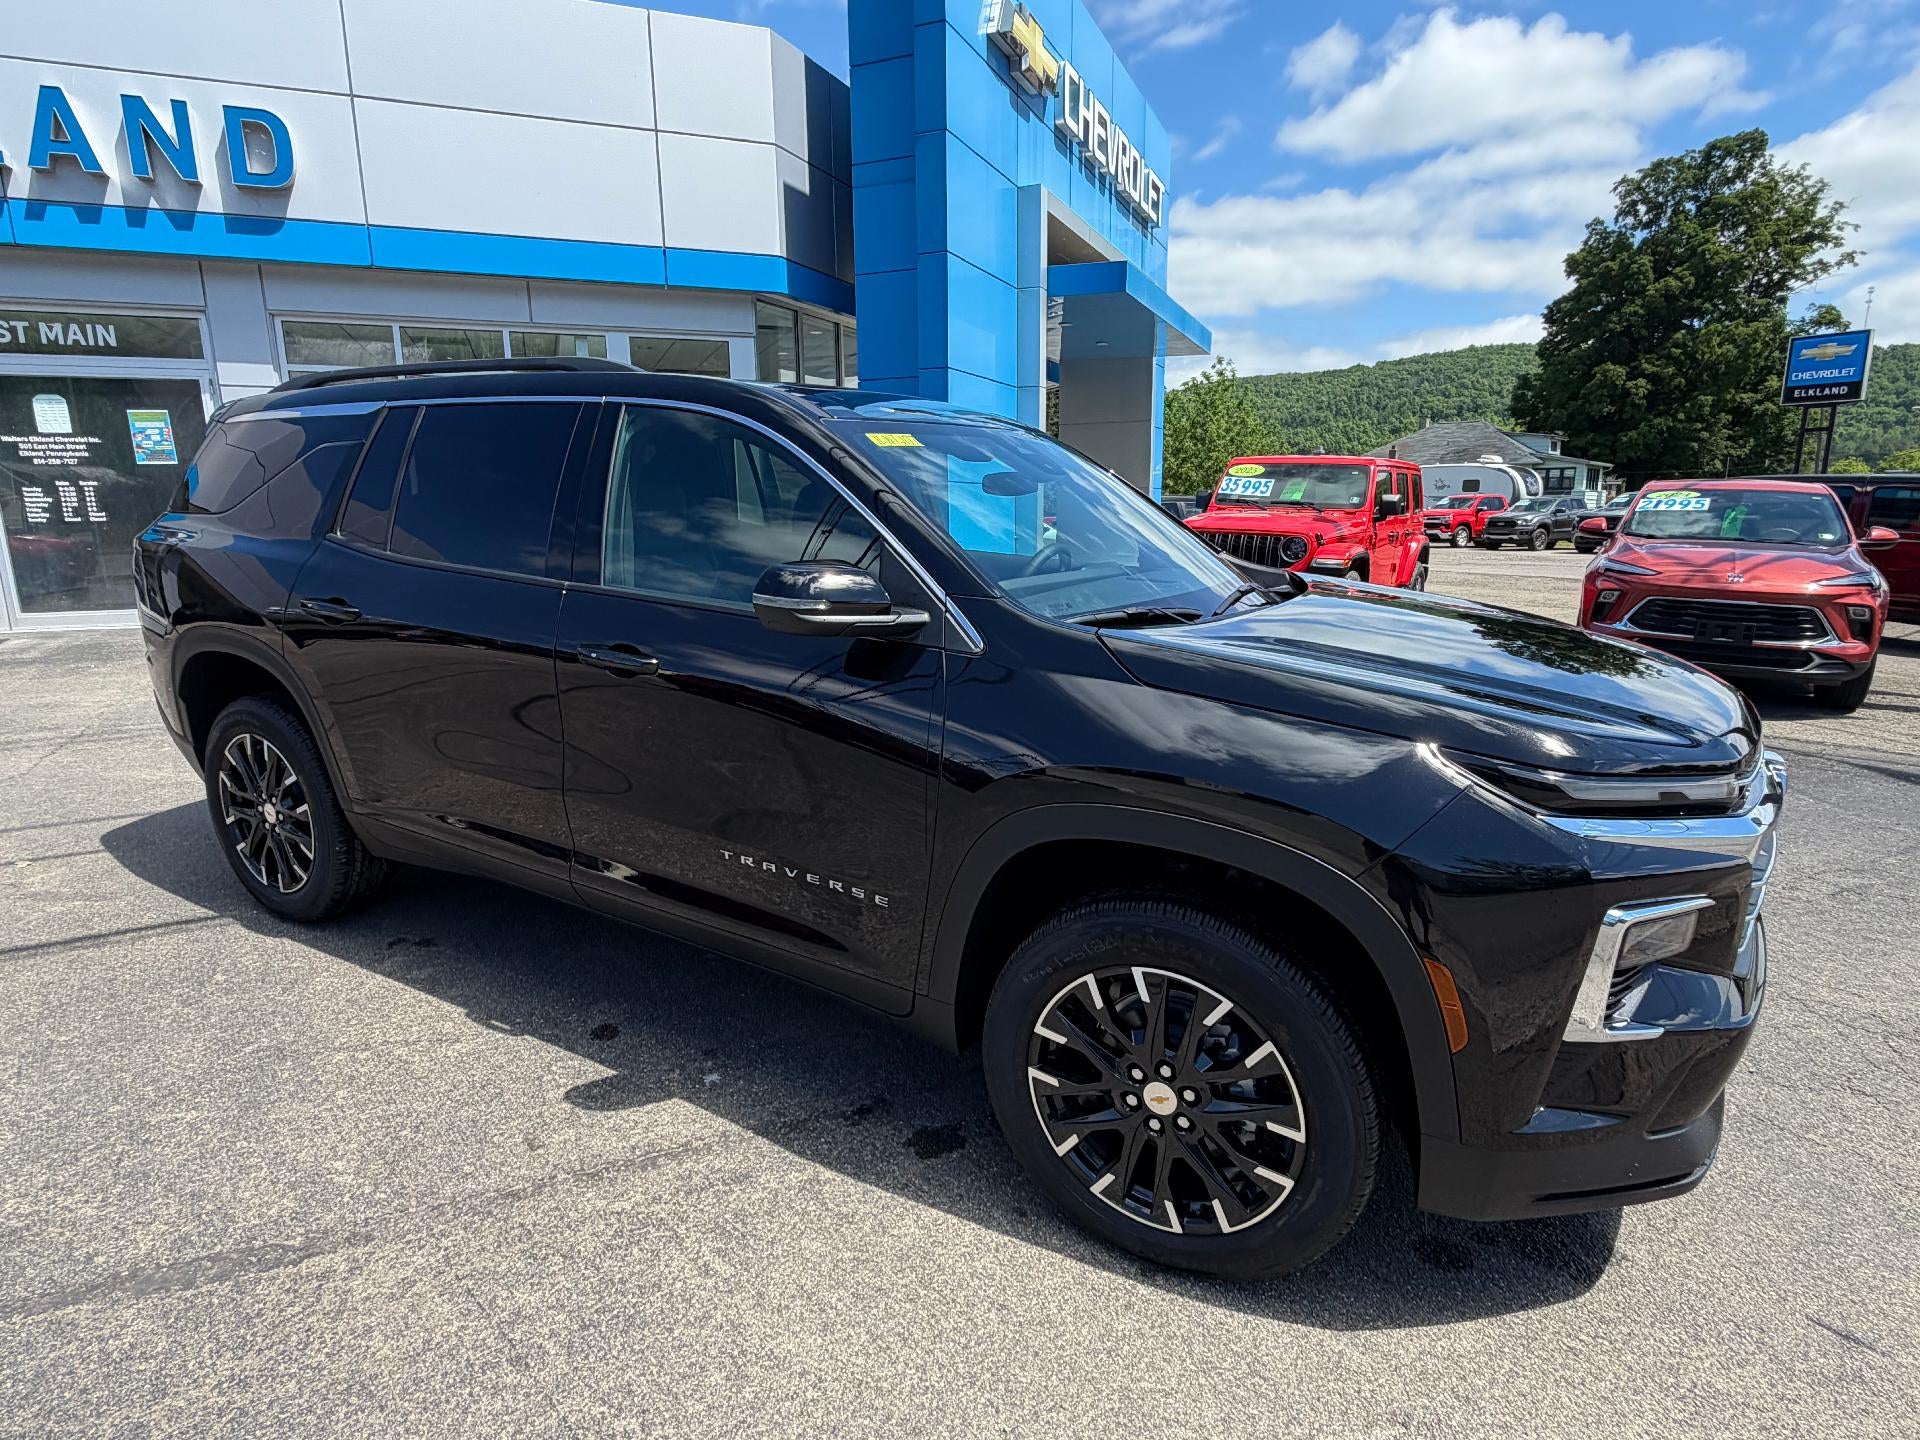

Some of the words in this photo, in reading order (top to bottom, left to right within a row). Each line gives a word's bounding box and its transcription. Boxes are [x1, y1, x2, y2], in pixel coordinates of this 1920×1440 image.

[0, 84, 294, 187] AND
[1057, 59, 1165, 228] CHEVROLET
[39, 322, 118, 347] MAIN
[1791, 367, 1856, 380] CHEVROLET
[1794, 386, 1848, 397] ELKLAND
[1221, 477, 1272, 494] 35995
[1640, 498, 1706, 509] 21995
[720, 849, 889, 907] TRAVERSE
